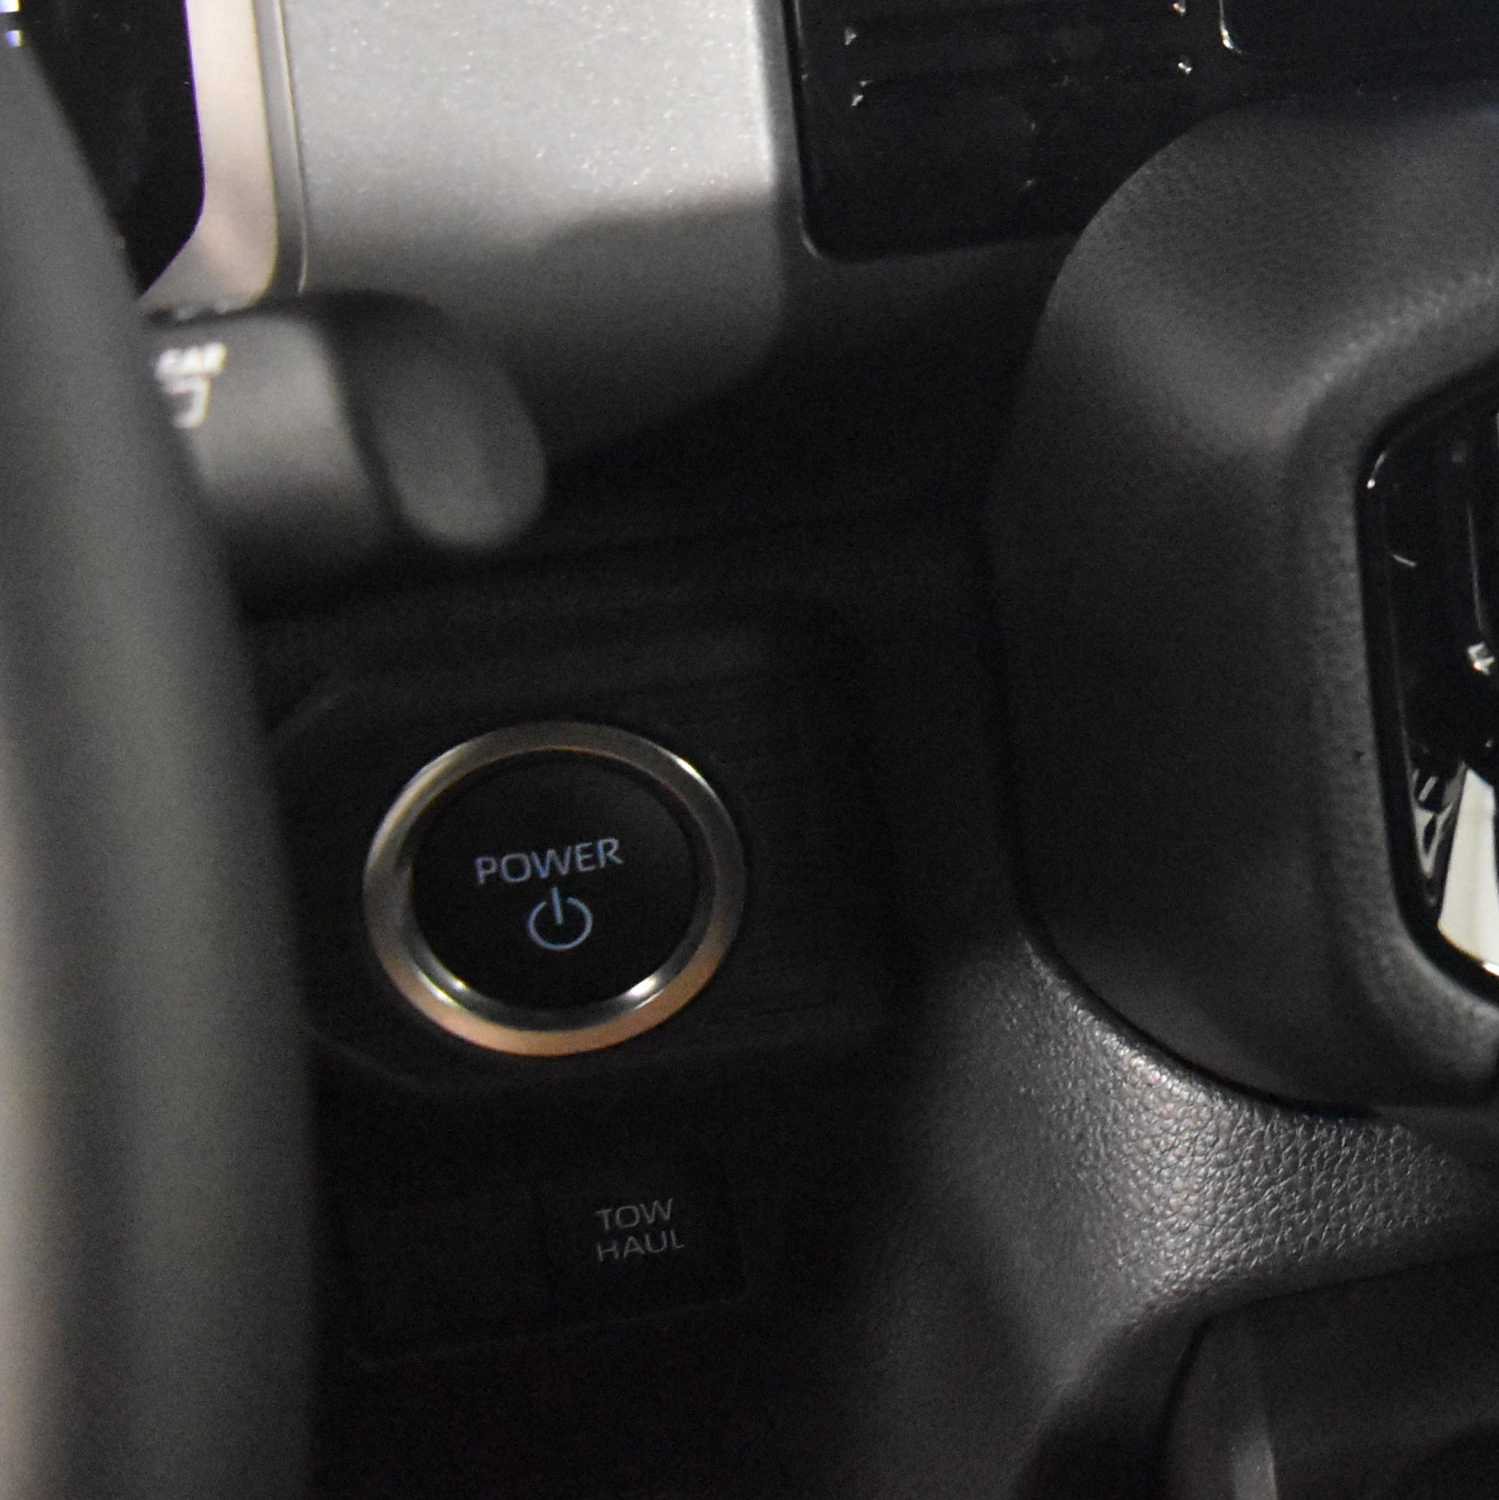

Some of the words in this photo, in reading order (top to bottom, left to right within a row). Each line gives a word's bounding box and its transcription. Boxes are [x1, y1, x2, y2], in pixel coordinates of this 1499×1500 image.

[476, 837, 624, 886] POWER
[596, 1198, 674, 1230] TOW
[598, 1228, 685, 1262] HAUL
